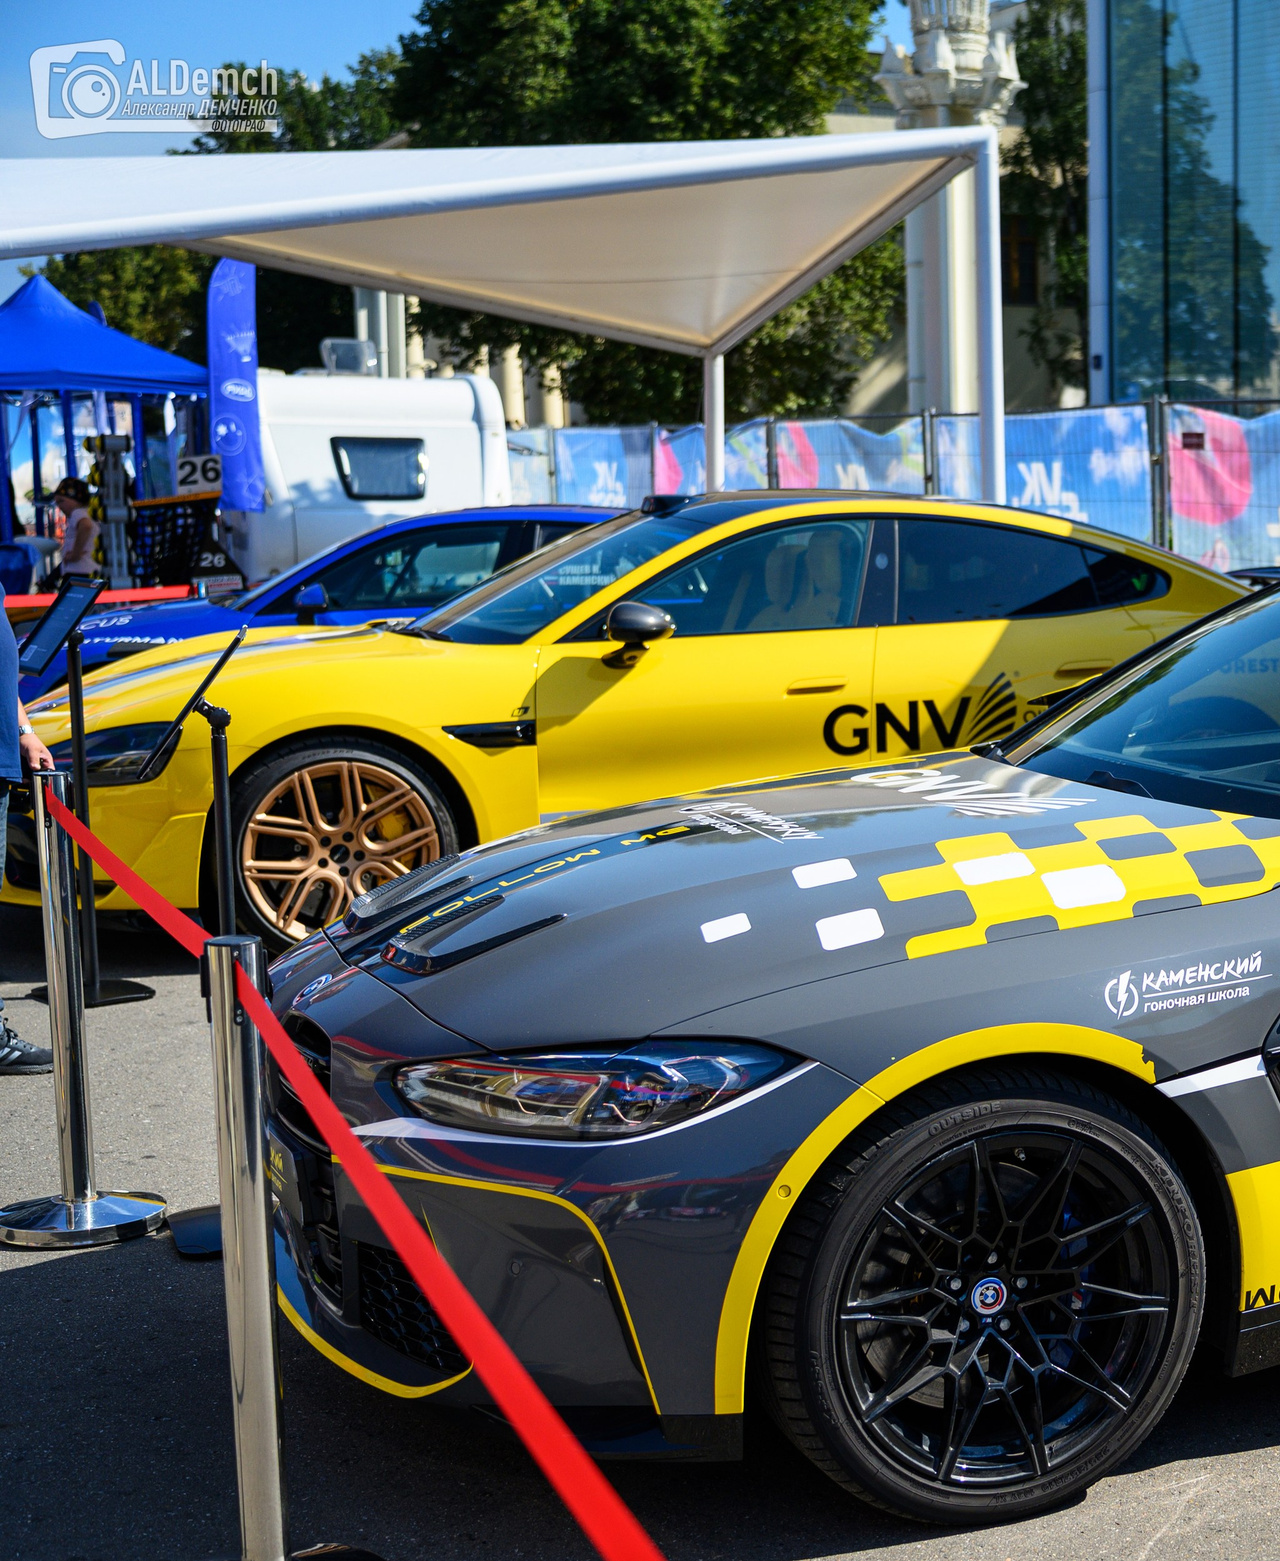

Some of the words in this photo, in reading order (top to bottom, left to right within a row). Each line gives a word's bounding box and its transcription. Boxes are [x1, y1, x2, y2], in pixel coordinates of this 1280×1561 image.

[177, 456, 222, 487] 26
[200, 552, 226, 568] 26
[822, 696, 973, 756] GNV
[850, 768, 1030, 802] GNV
[398, 848, 602, 935] FOLLOW
[1142, 950, 1262, 992] КАМЕНСКИЙ
[1143, 990, 1206, 1013] гоночная
[1206, 985, 1251, 1004] школа
[927, 1101, 1002, 1137] OUTSIDE
